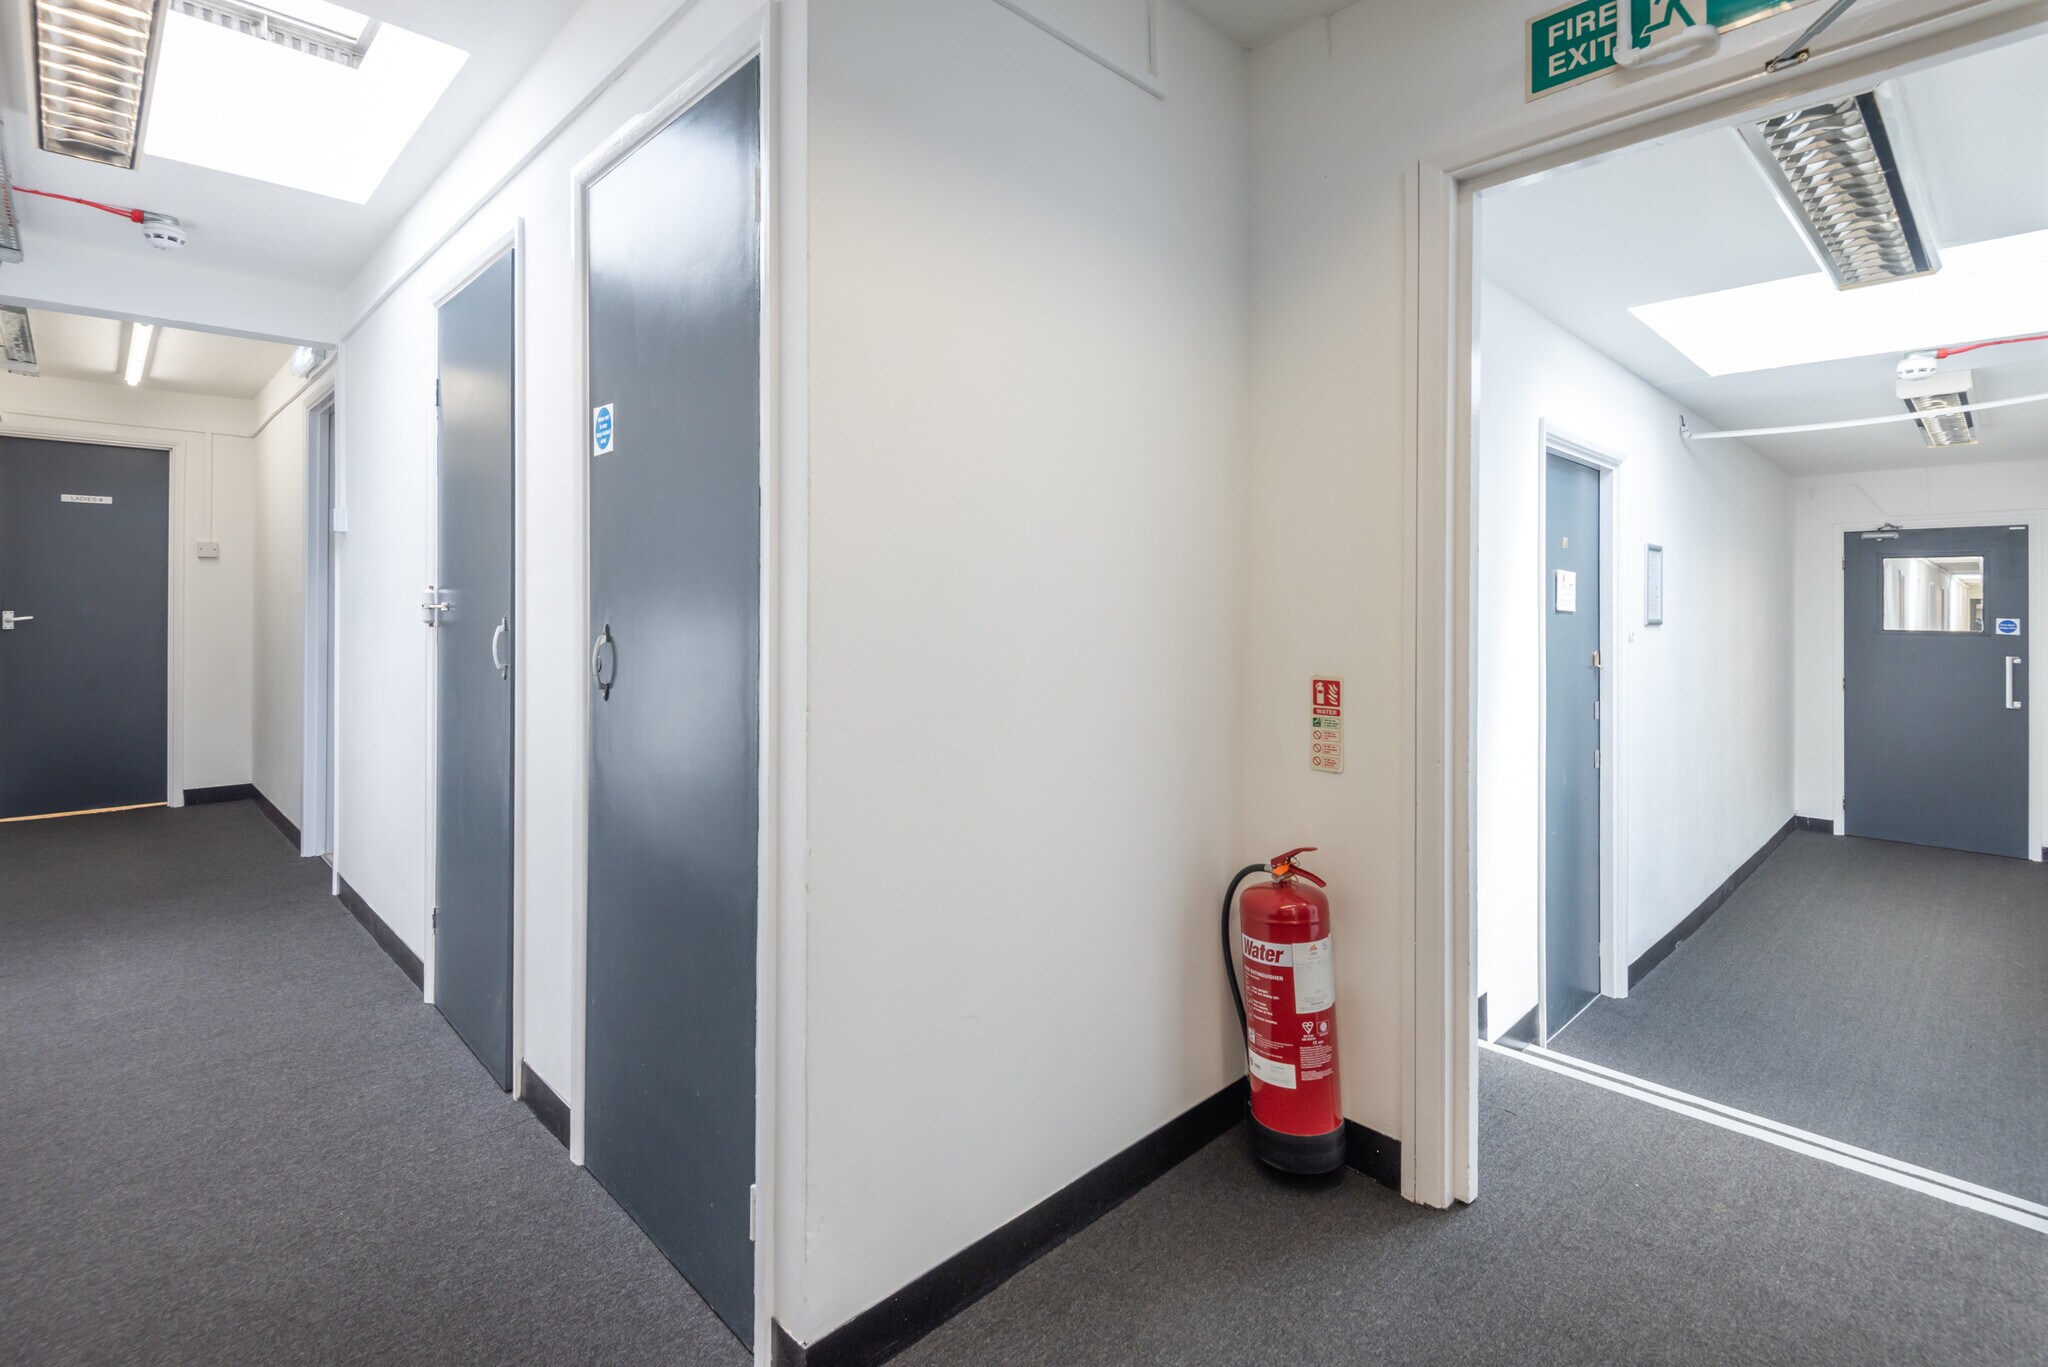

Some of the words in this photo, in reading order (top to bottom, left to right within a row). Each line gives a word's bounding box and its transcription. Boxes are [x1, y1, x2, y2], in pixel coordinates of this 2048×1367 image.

[1548, 1, 1617, 47] FIRE
[1548, 32, 1618, 78] EXIT
[1316, 708, 1338, 716] WATER
[1243, 936, 1284, 964] Water
